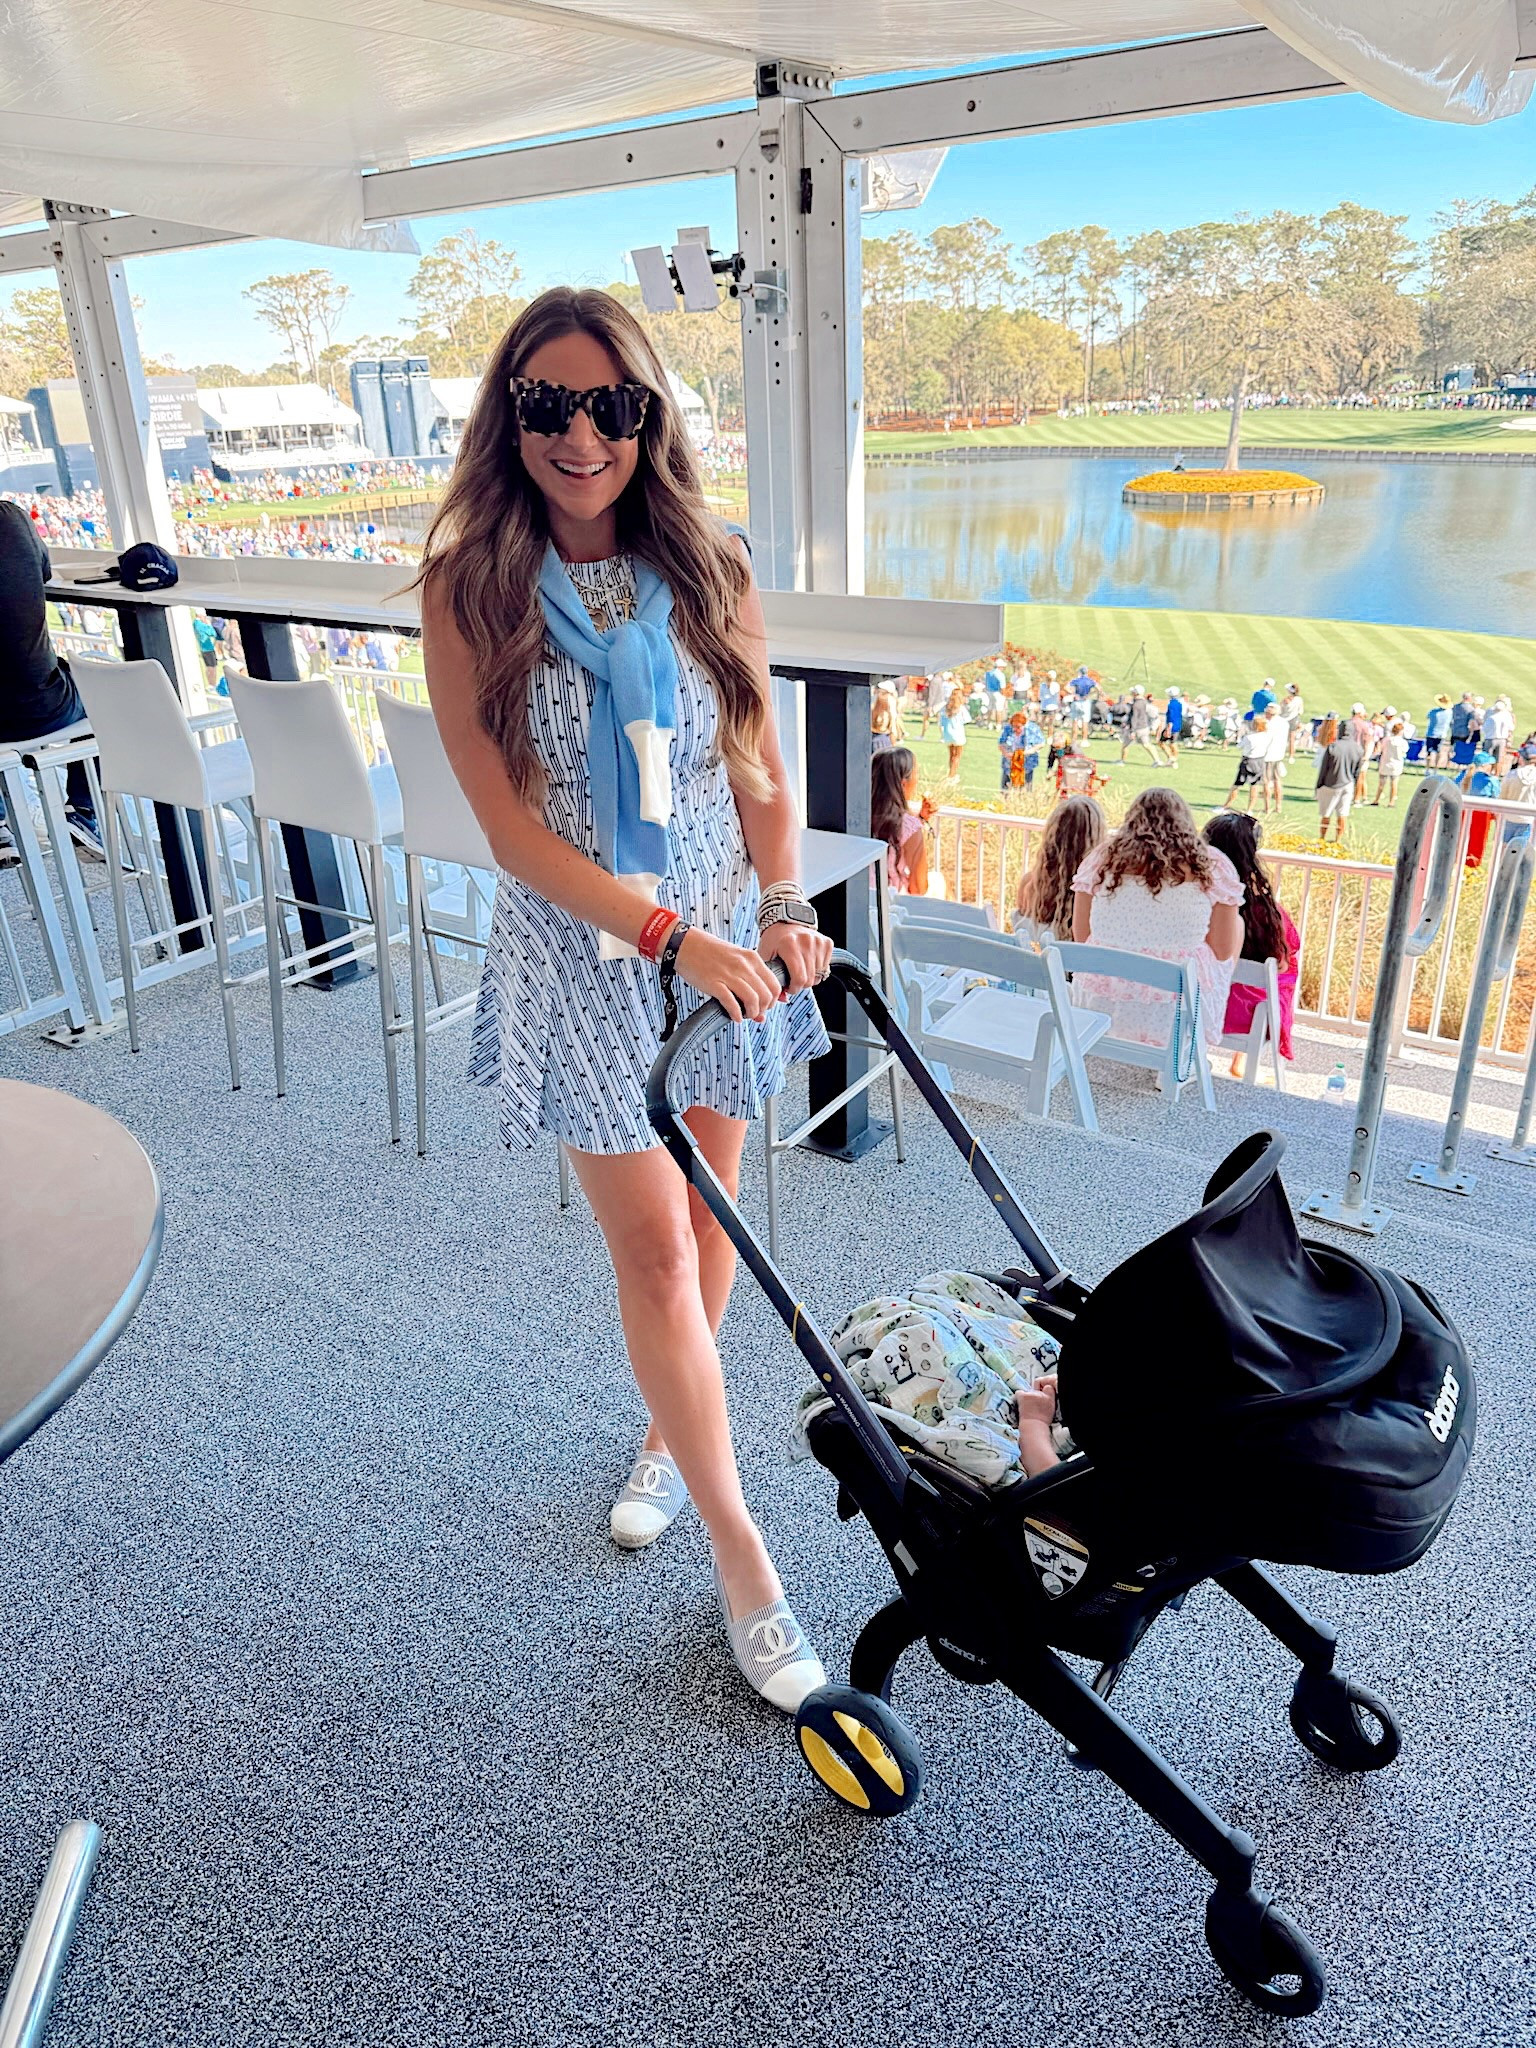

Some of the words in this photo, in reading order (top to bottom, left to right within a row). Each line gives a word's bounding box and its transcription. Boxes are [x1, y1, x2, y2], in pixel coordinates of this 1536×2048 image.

[839, 1396, 861, 1428] WARNING
[1424, 1367, 1461, 1444] doona
[939, 1637, 975, 1662] doona
